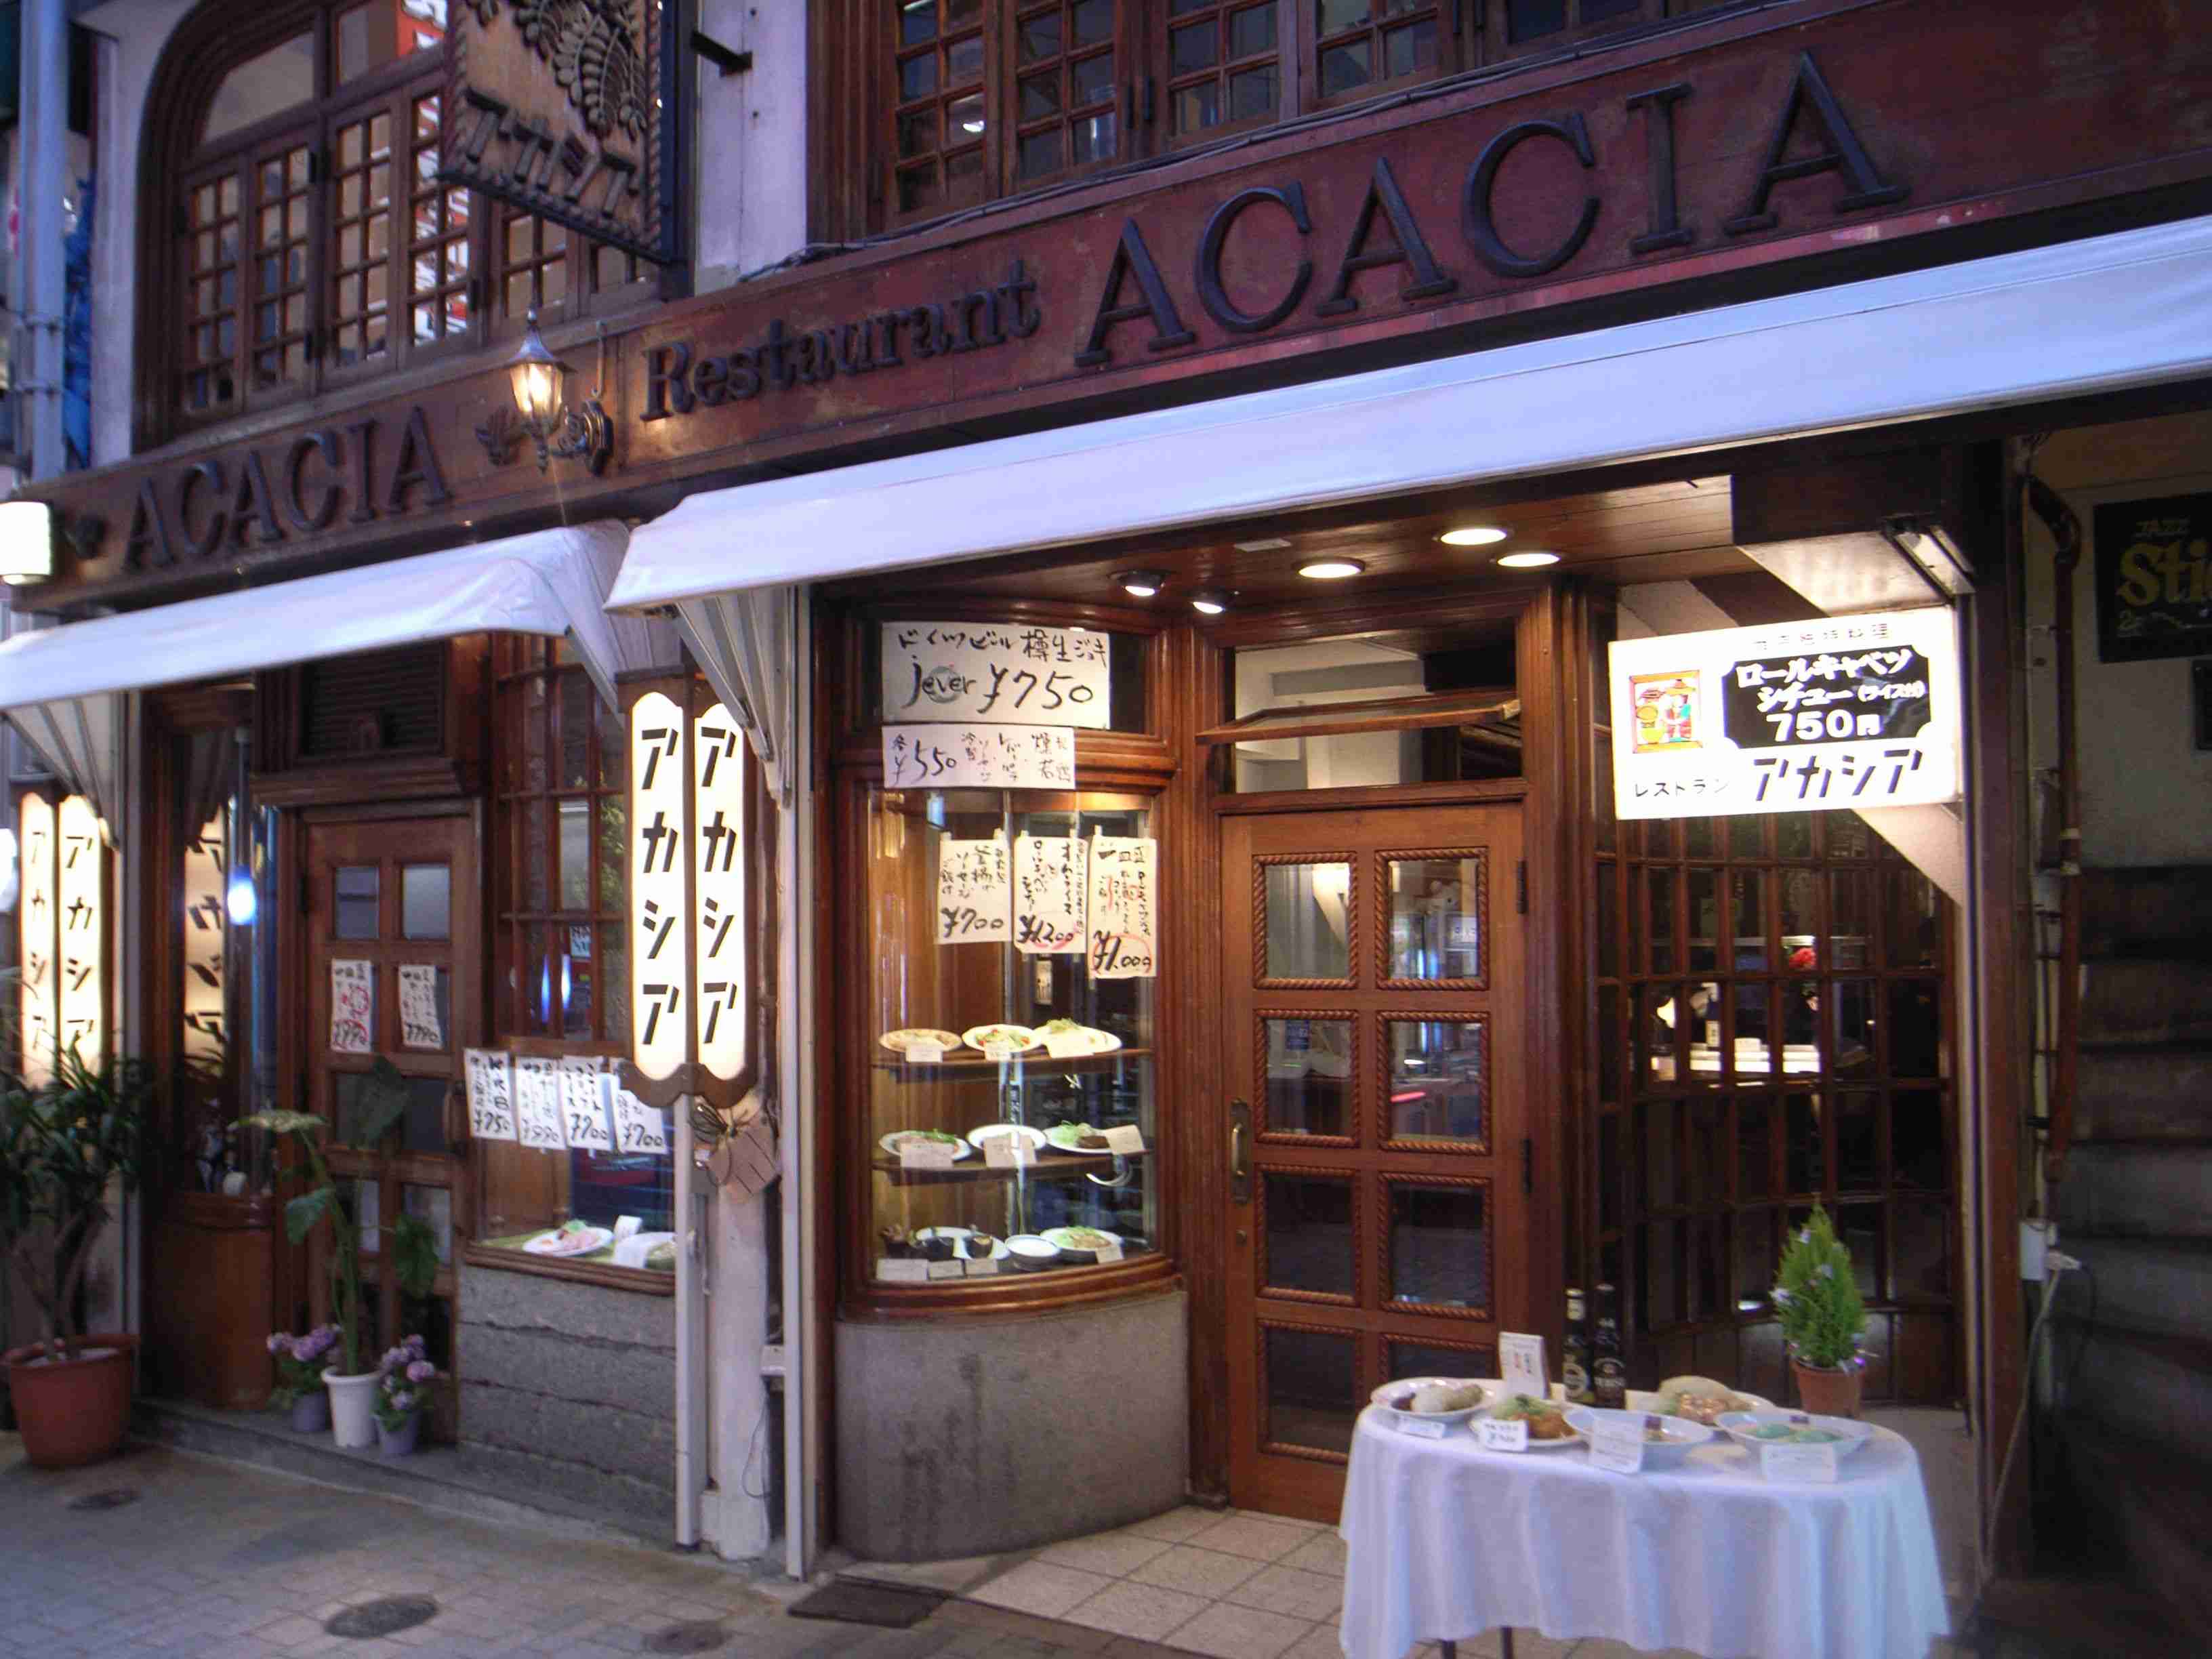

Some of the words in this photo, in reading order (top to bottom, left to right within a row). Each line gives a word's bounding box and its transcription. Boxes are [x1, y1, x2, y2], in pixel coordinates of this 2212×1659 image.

[639, 259, 1041, 422] Restaurant
[1076, 50, 1910, 367] ACACIA
[127, 405, 455, 571] ACACIA
[901, 655, 977, 710] jever
[977, 663, 1094, 714] ¥750
[1736, 649, 1913, 688] ロールキャベツ
[1635, 777, 1730, 798] レストラン
[1754, 749, 1923, 801] アカシア
[1766, 709, 1883, 742] 750円
[66, 836, 94, 1045] アカシア
[641, 727, 680, 1045] アカシア
[701, 726, 737, 1044] アカシア
[941, 906, 1005, 939] ¥700
